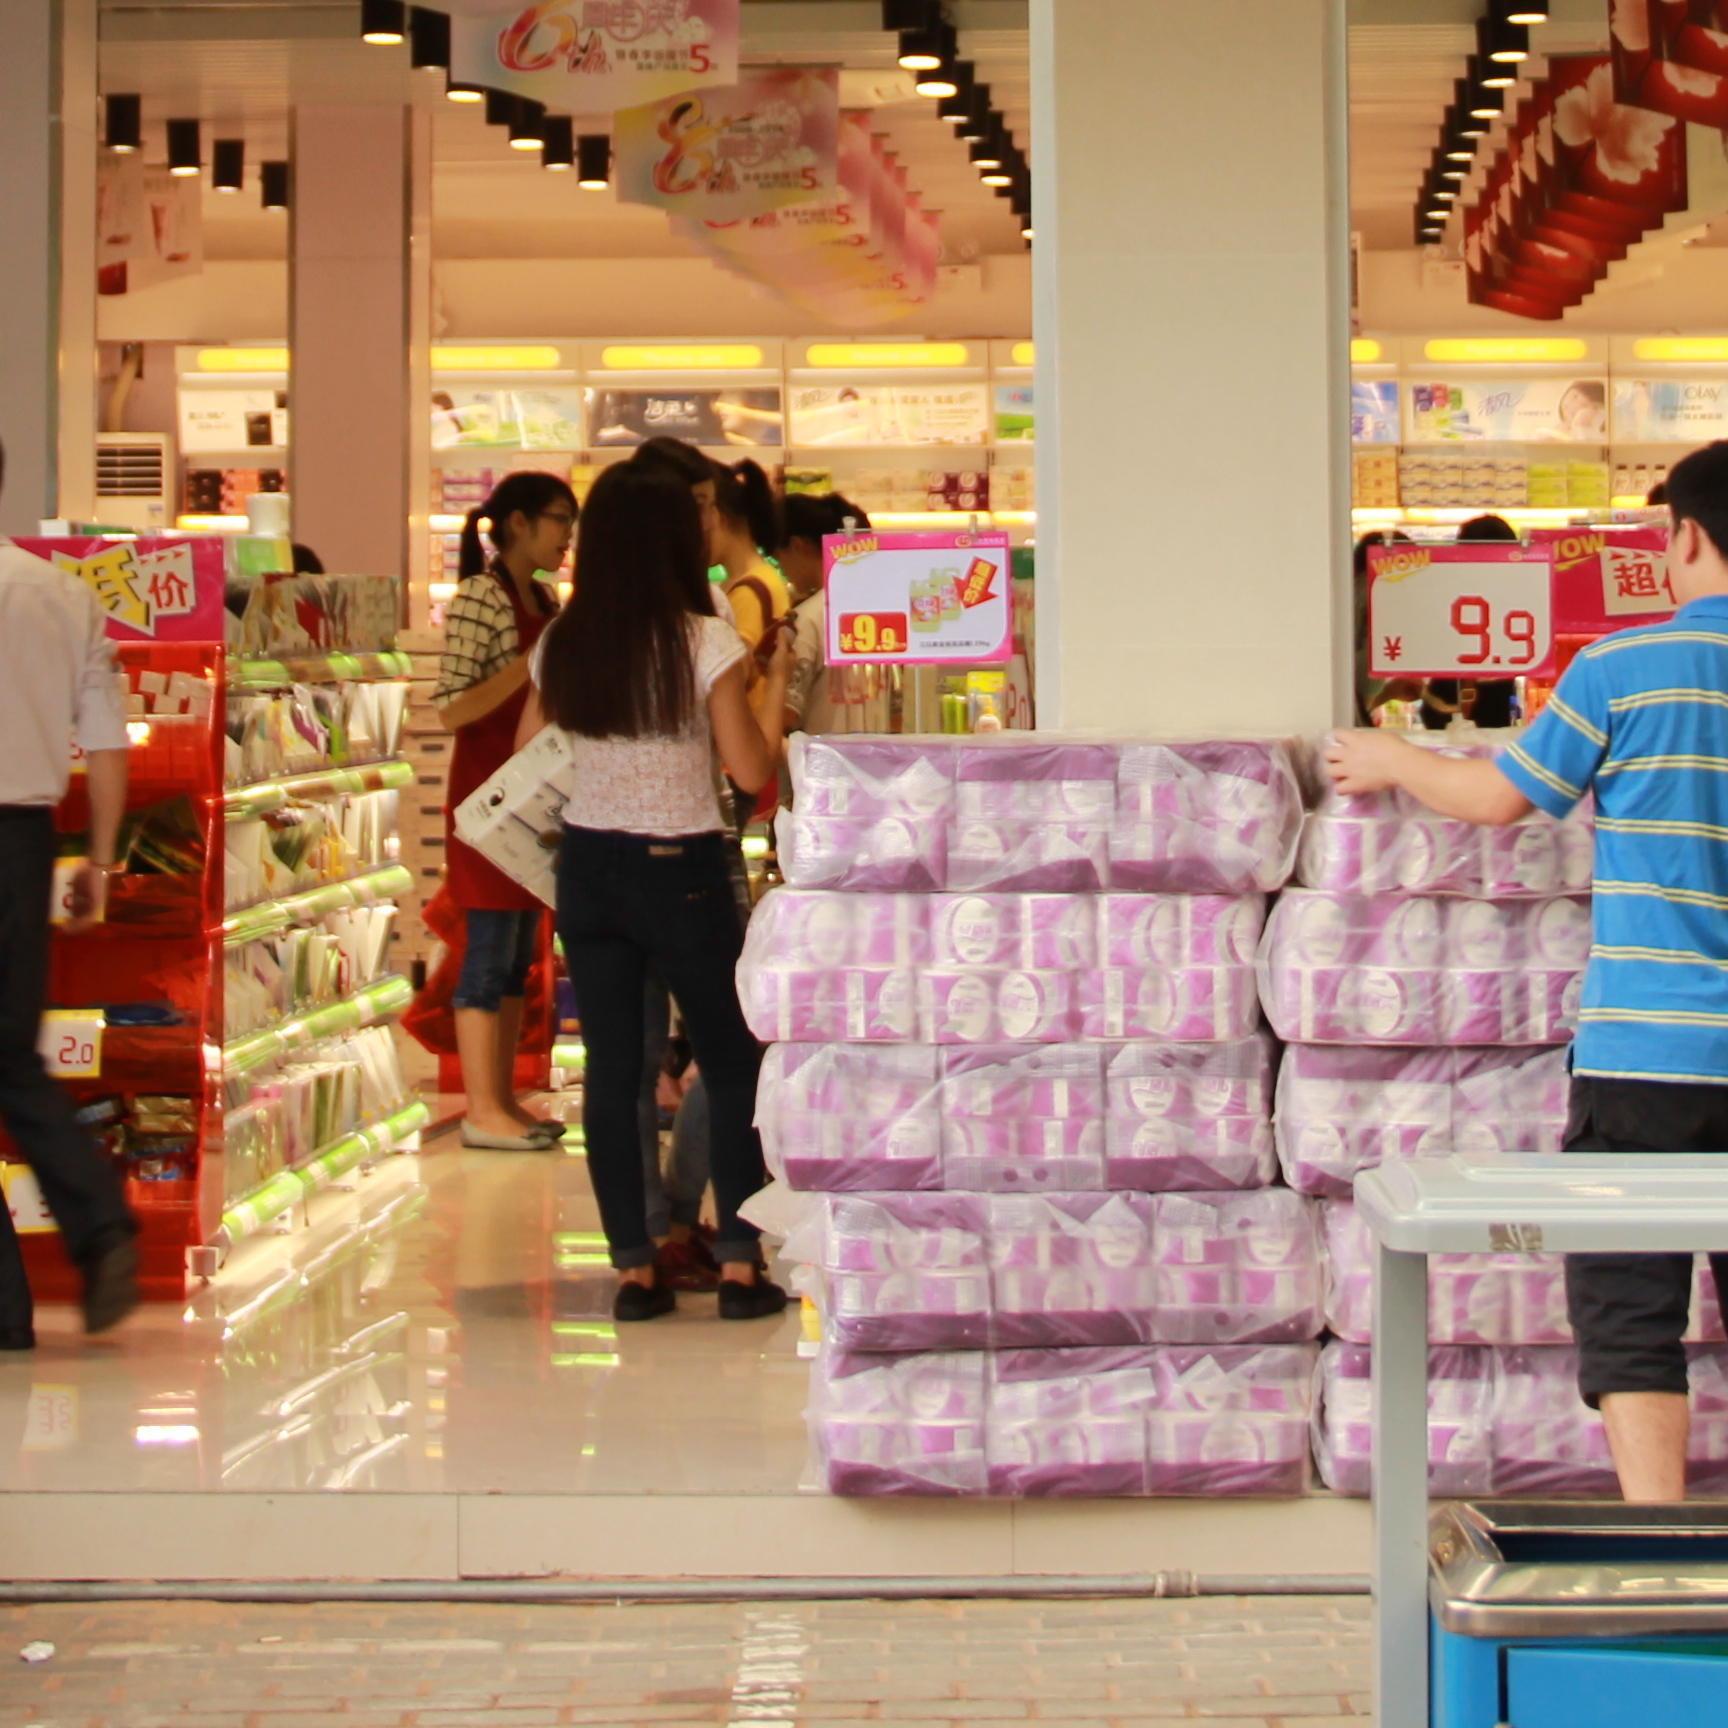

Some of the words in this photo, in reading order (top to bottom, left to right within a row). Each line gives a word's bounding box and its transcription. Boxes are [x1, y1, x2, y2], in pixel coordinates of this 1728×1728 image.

[829, 537, 880, 560] WOW
[1553, 533, 1607, 560] OW
[1372, 549, 1431, 575] WOW
[1450, 595, 1535, 665] 9.9
